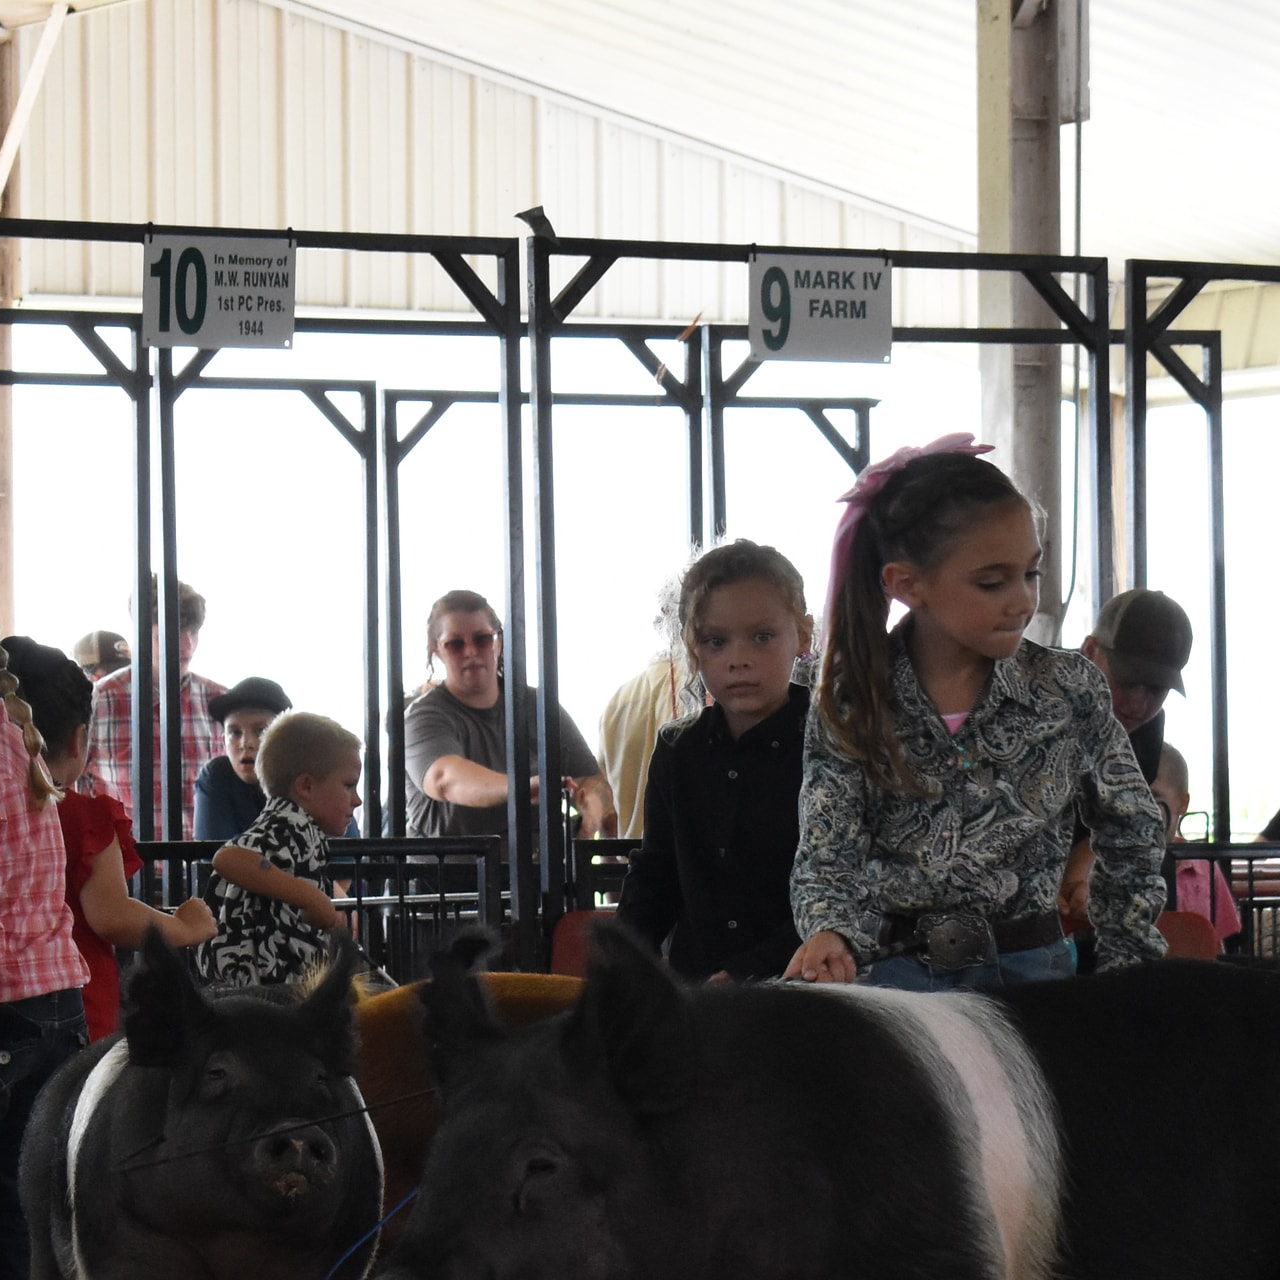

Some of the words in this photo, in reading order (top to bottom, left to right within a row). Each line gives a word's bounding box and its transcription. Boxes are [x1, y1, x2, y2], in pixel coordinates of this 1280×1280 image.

[214, 254, 224, 264] In
[228, 254, 272, 268] Memory
[277, 256, 288, 266] of
[214, 271, 239, 287] M.W.
[244, 271, 289, 288] RUNYAN
[794, 270, 855, 290] MARK
[863, 272, 882, 290] IV
[150, 247, 208, 335] 10
[218, 296, 234, 311] 1st
[238, 296, 252, 311] PC
[257, 296, 285, 312] Pres.
[761, 266, 791, 351] 9
[809, 300, 866, 319] FARM
[239, 320, 263, 336] 1944
